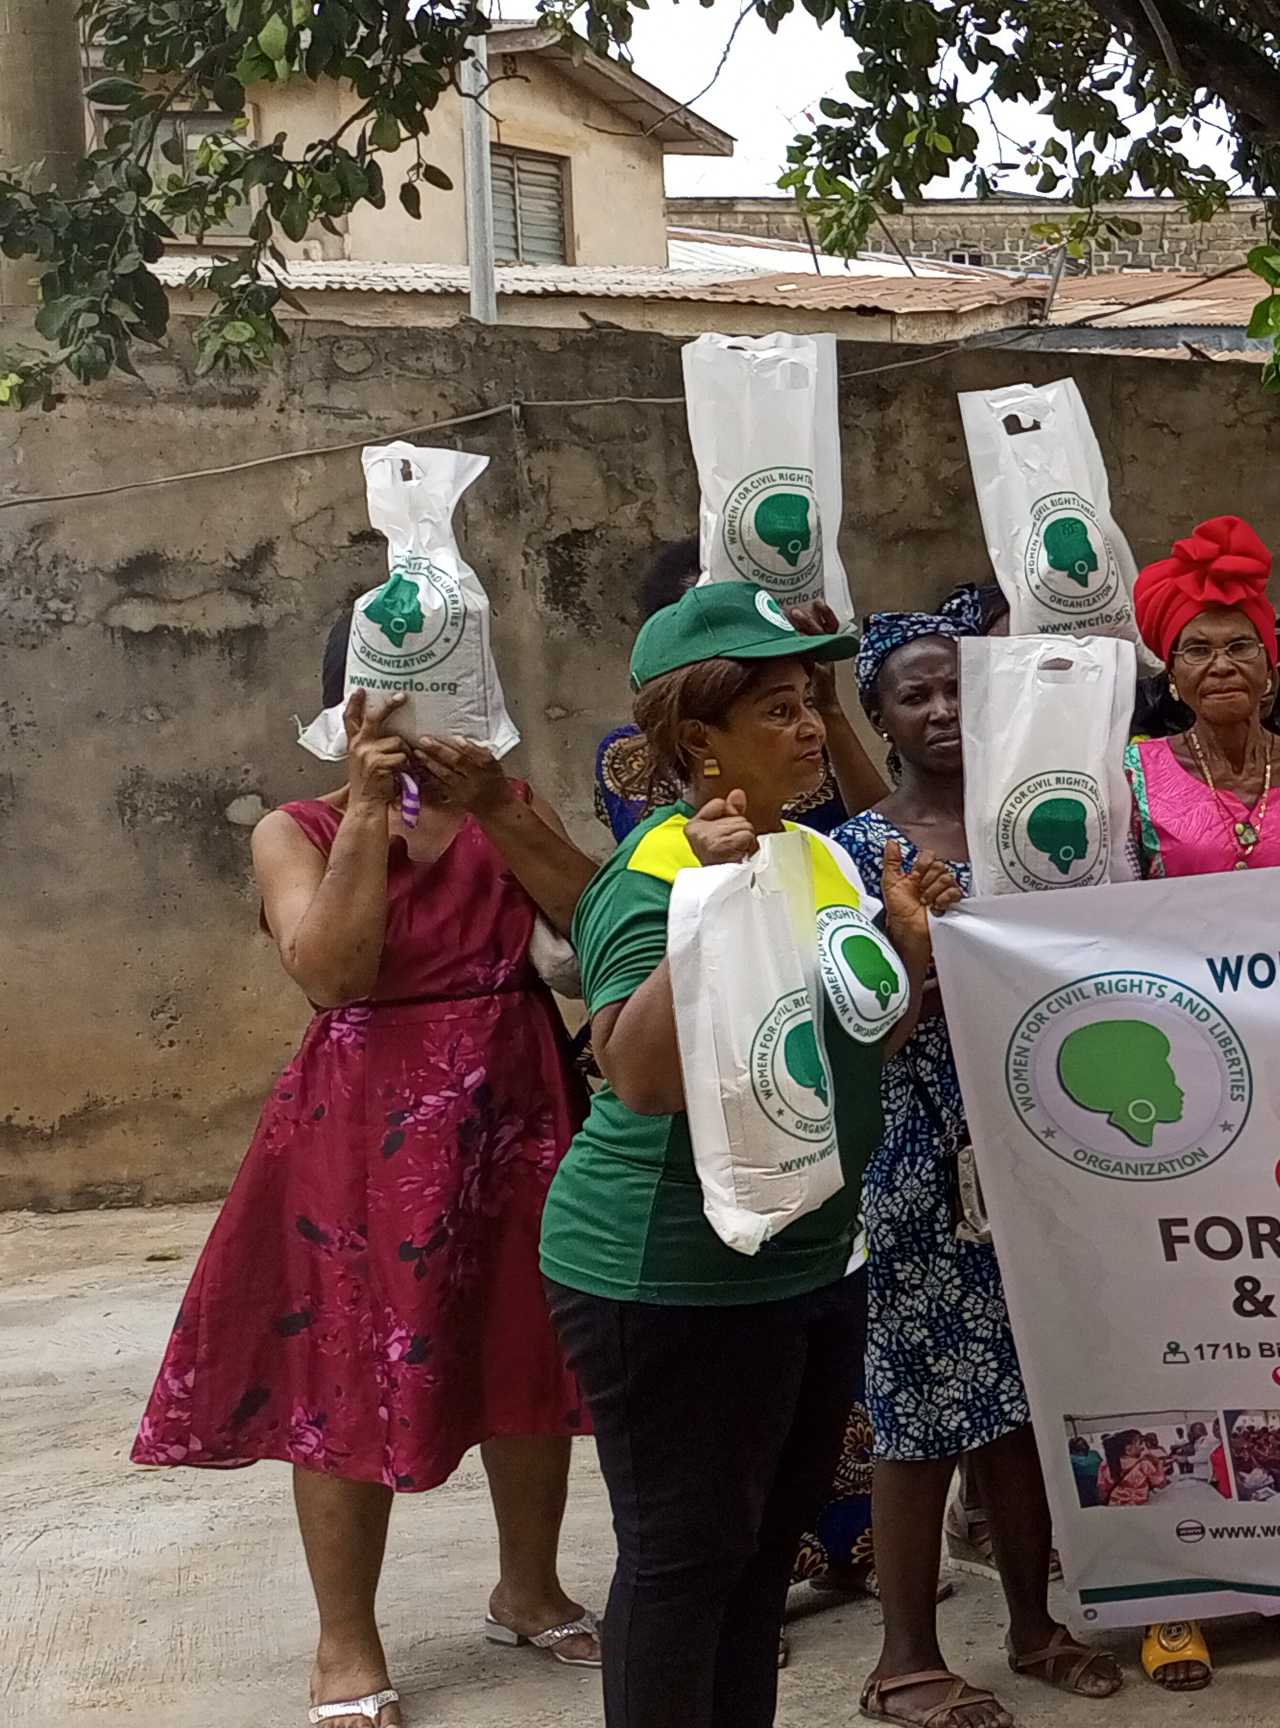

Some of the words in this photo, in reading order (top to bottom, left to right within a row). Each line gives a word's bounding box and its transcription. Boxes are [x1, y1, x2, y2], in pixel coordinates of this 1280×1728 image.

[728, 506, 739, 545] WOMEN
[736, 487, 751, 506] FOR
[751, 475, 776, 489] CIVIL
[1050, 584, 1113, 609] ORGANIZATION
[360, 646, 436, 668] ORGANIZATION
[349, 675, 459, 695] www.wcrlo.org
[1001, 811, 1014, 850] WOMEN
[1010, 791, 1028, 811] FOR
[1027, 779, 1052, 794] CIVIL
[1055, 777, 1088, 788] RIGHTS
[826, 909, 863, 924] RIGHTS
[827, 967, 850, 1016] WOMEN
[1046, 988, 1091, 1015] CIVIL
[1093, 978, 1169, 998] RIGHTS
[1169, 992, 1211, 1023] AND
[760, 1025, 776, 1049] FOR
[1021, 1013, 1050, 1043] FOR
[756, 1053, 773, 1101] WOMEN
[1208, 1022, 1246, 1103] LIBERTIES
[1012, 1046, 1037, 1113] WOMEN
[1073, 1147, 1209, 1176] ORGANIZATION
[1232, 1275, 1277, 1318] &
[1193, 1342, 1251, 1361] 171b
